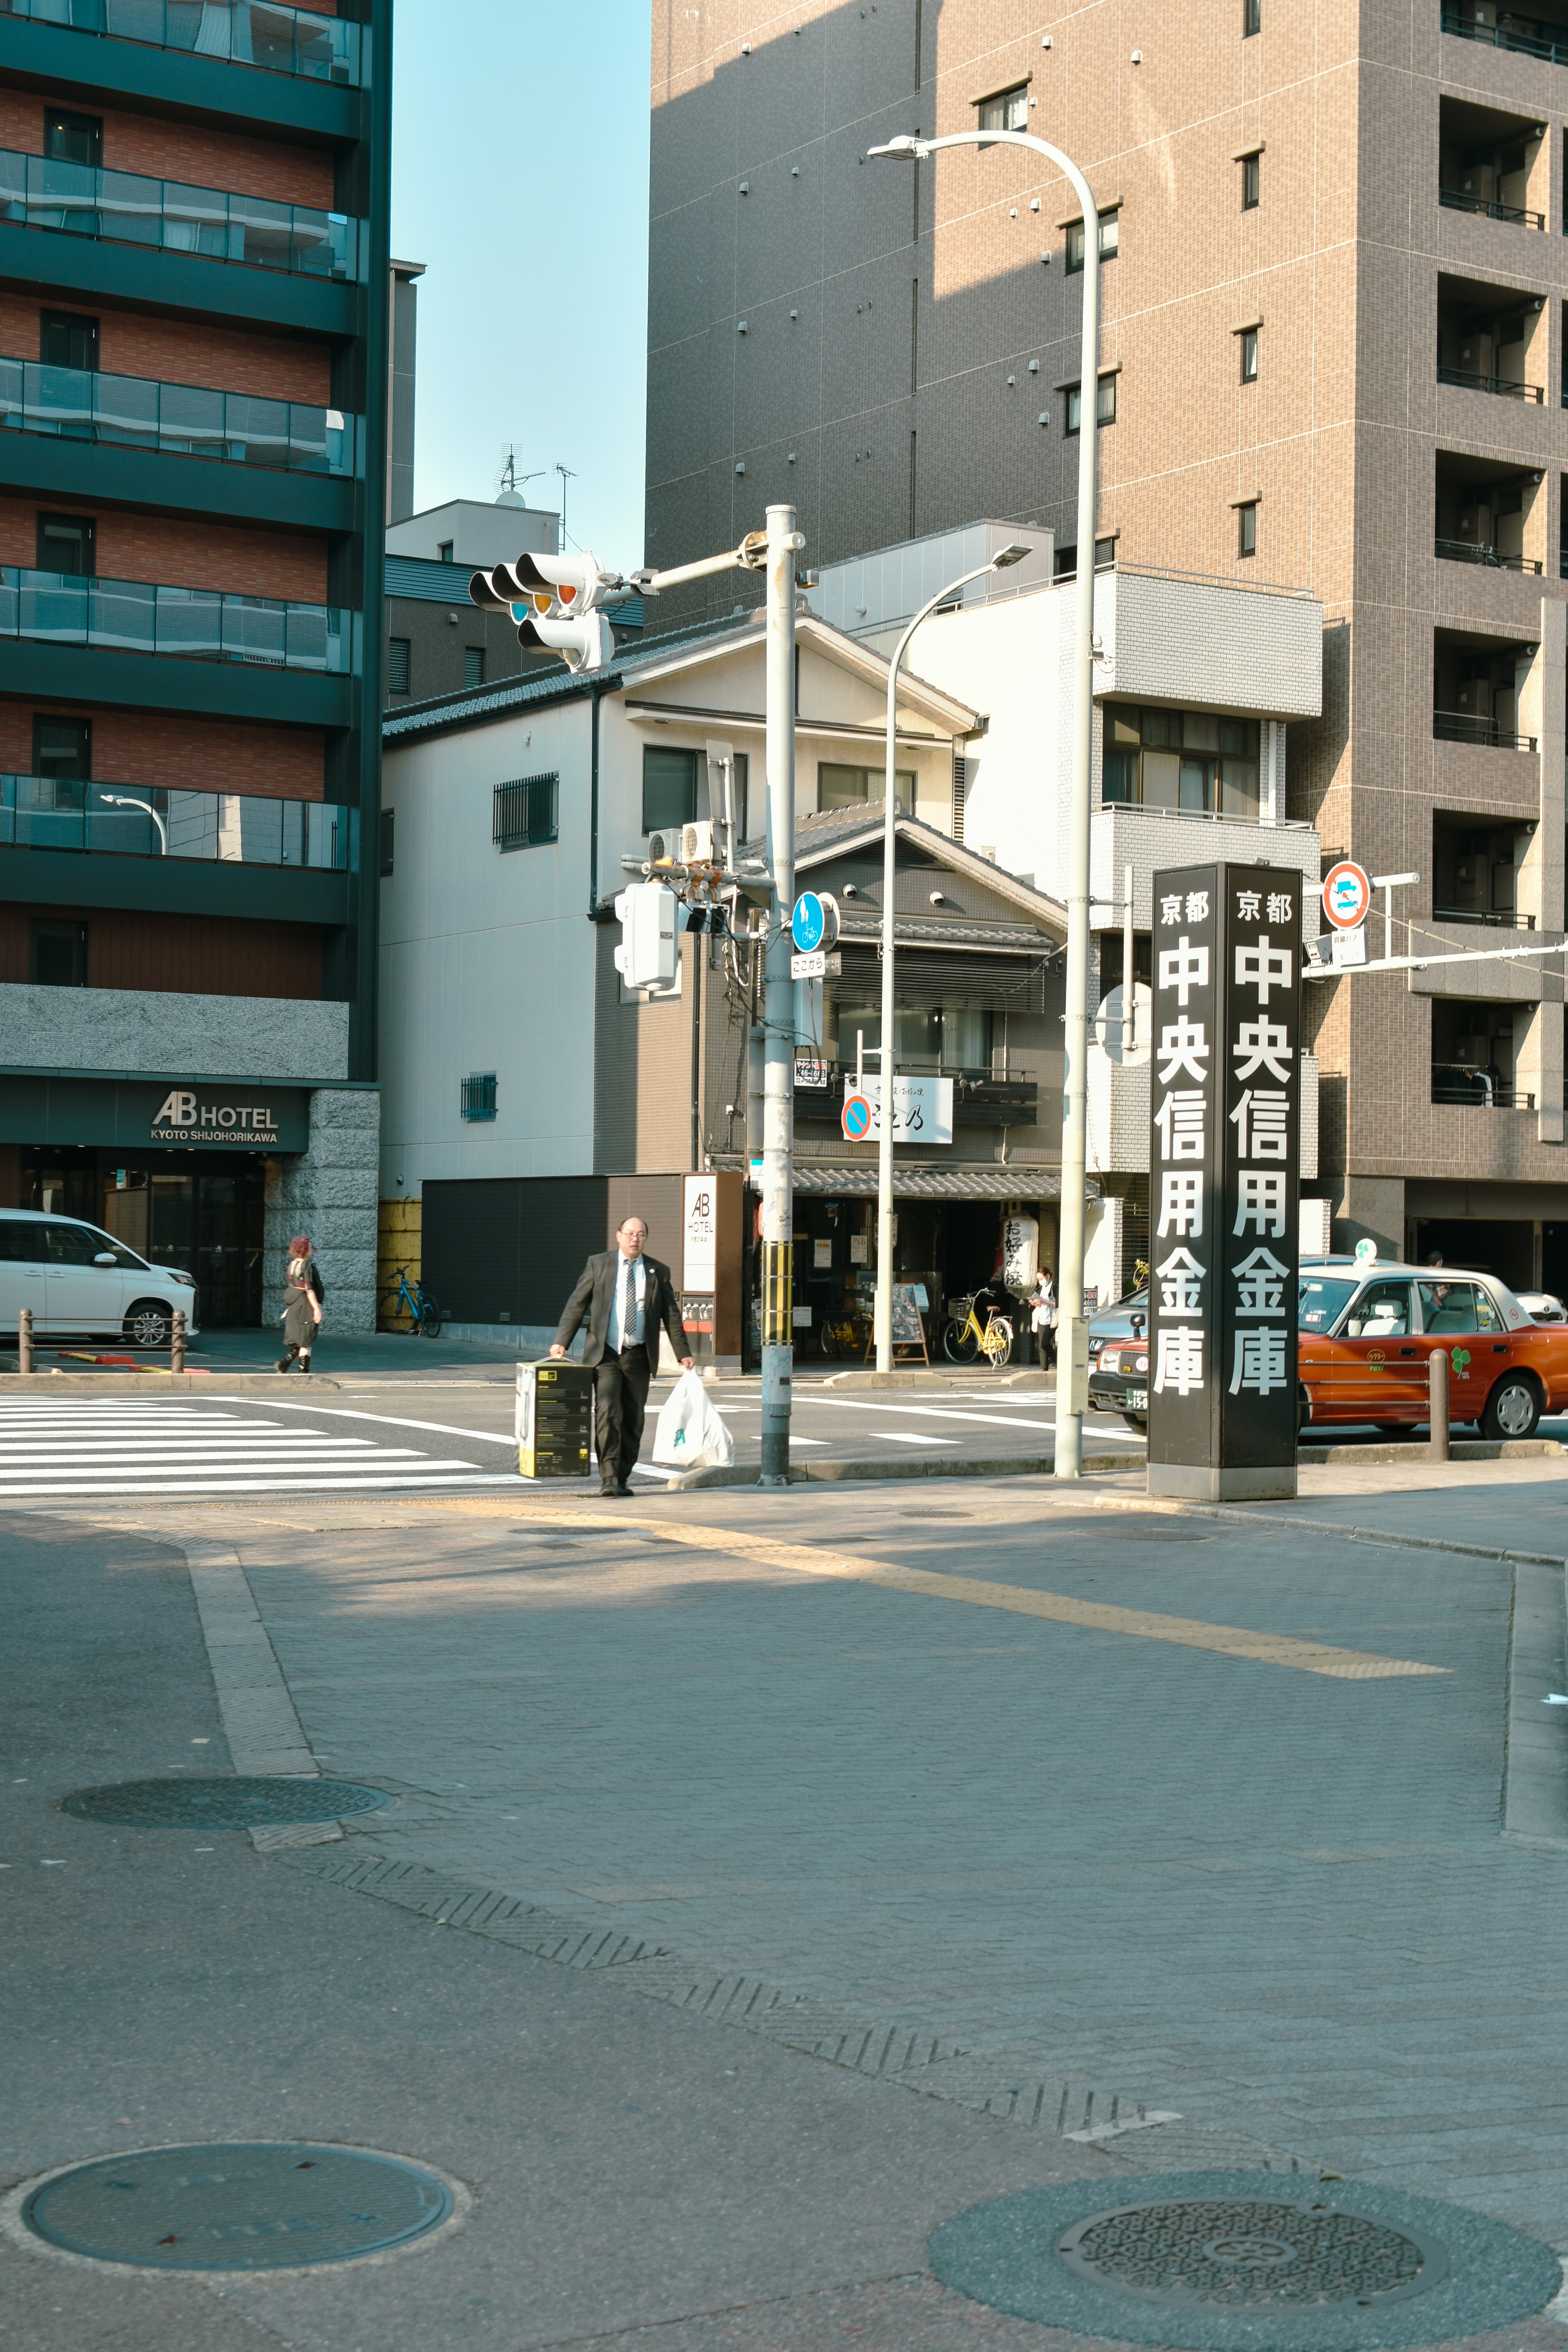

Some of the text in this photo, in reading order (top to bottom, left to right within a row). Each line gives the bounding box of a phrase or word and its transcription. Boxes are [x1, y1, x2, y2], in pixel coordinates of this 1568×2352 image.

[1160, 891, 1209, 925] 京都
[1236, 890, 1292, 924] 京都
[793, 958, 822, 972] ここから
[152, 1091, 278, 1129] AB HOTEL
[151, 1130, 277, 1143] KYOTO SHIJOHORIKAWA
[1153, 936, 1209, 1396] 中央信用金庫
[1229, 935, 1293, 1396] 中央信用金庫
[692, 1193, 710, 1217] AB
[688, 1221, 713, 1232] HOTEL
[1133, 1396, 1148, 1409] 15-0
